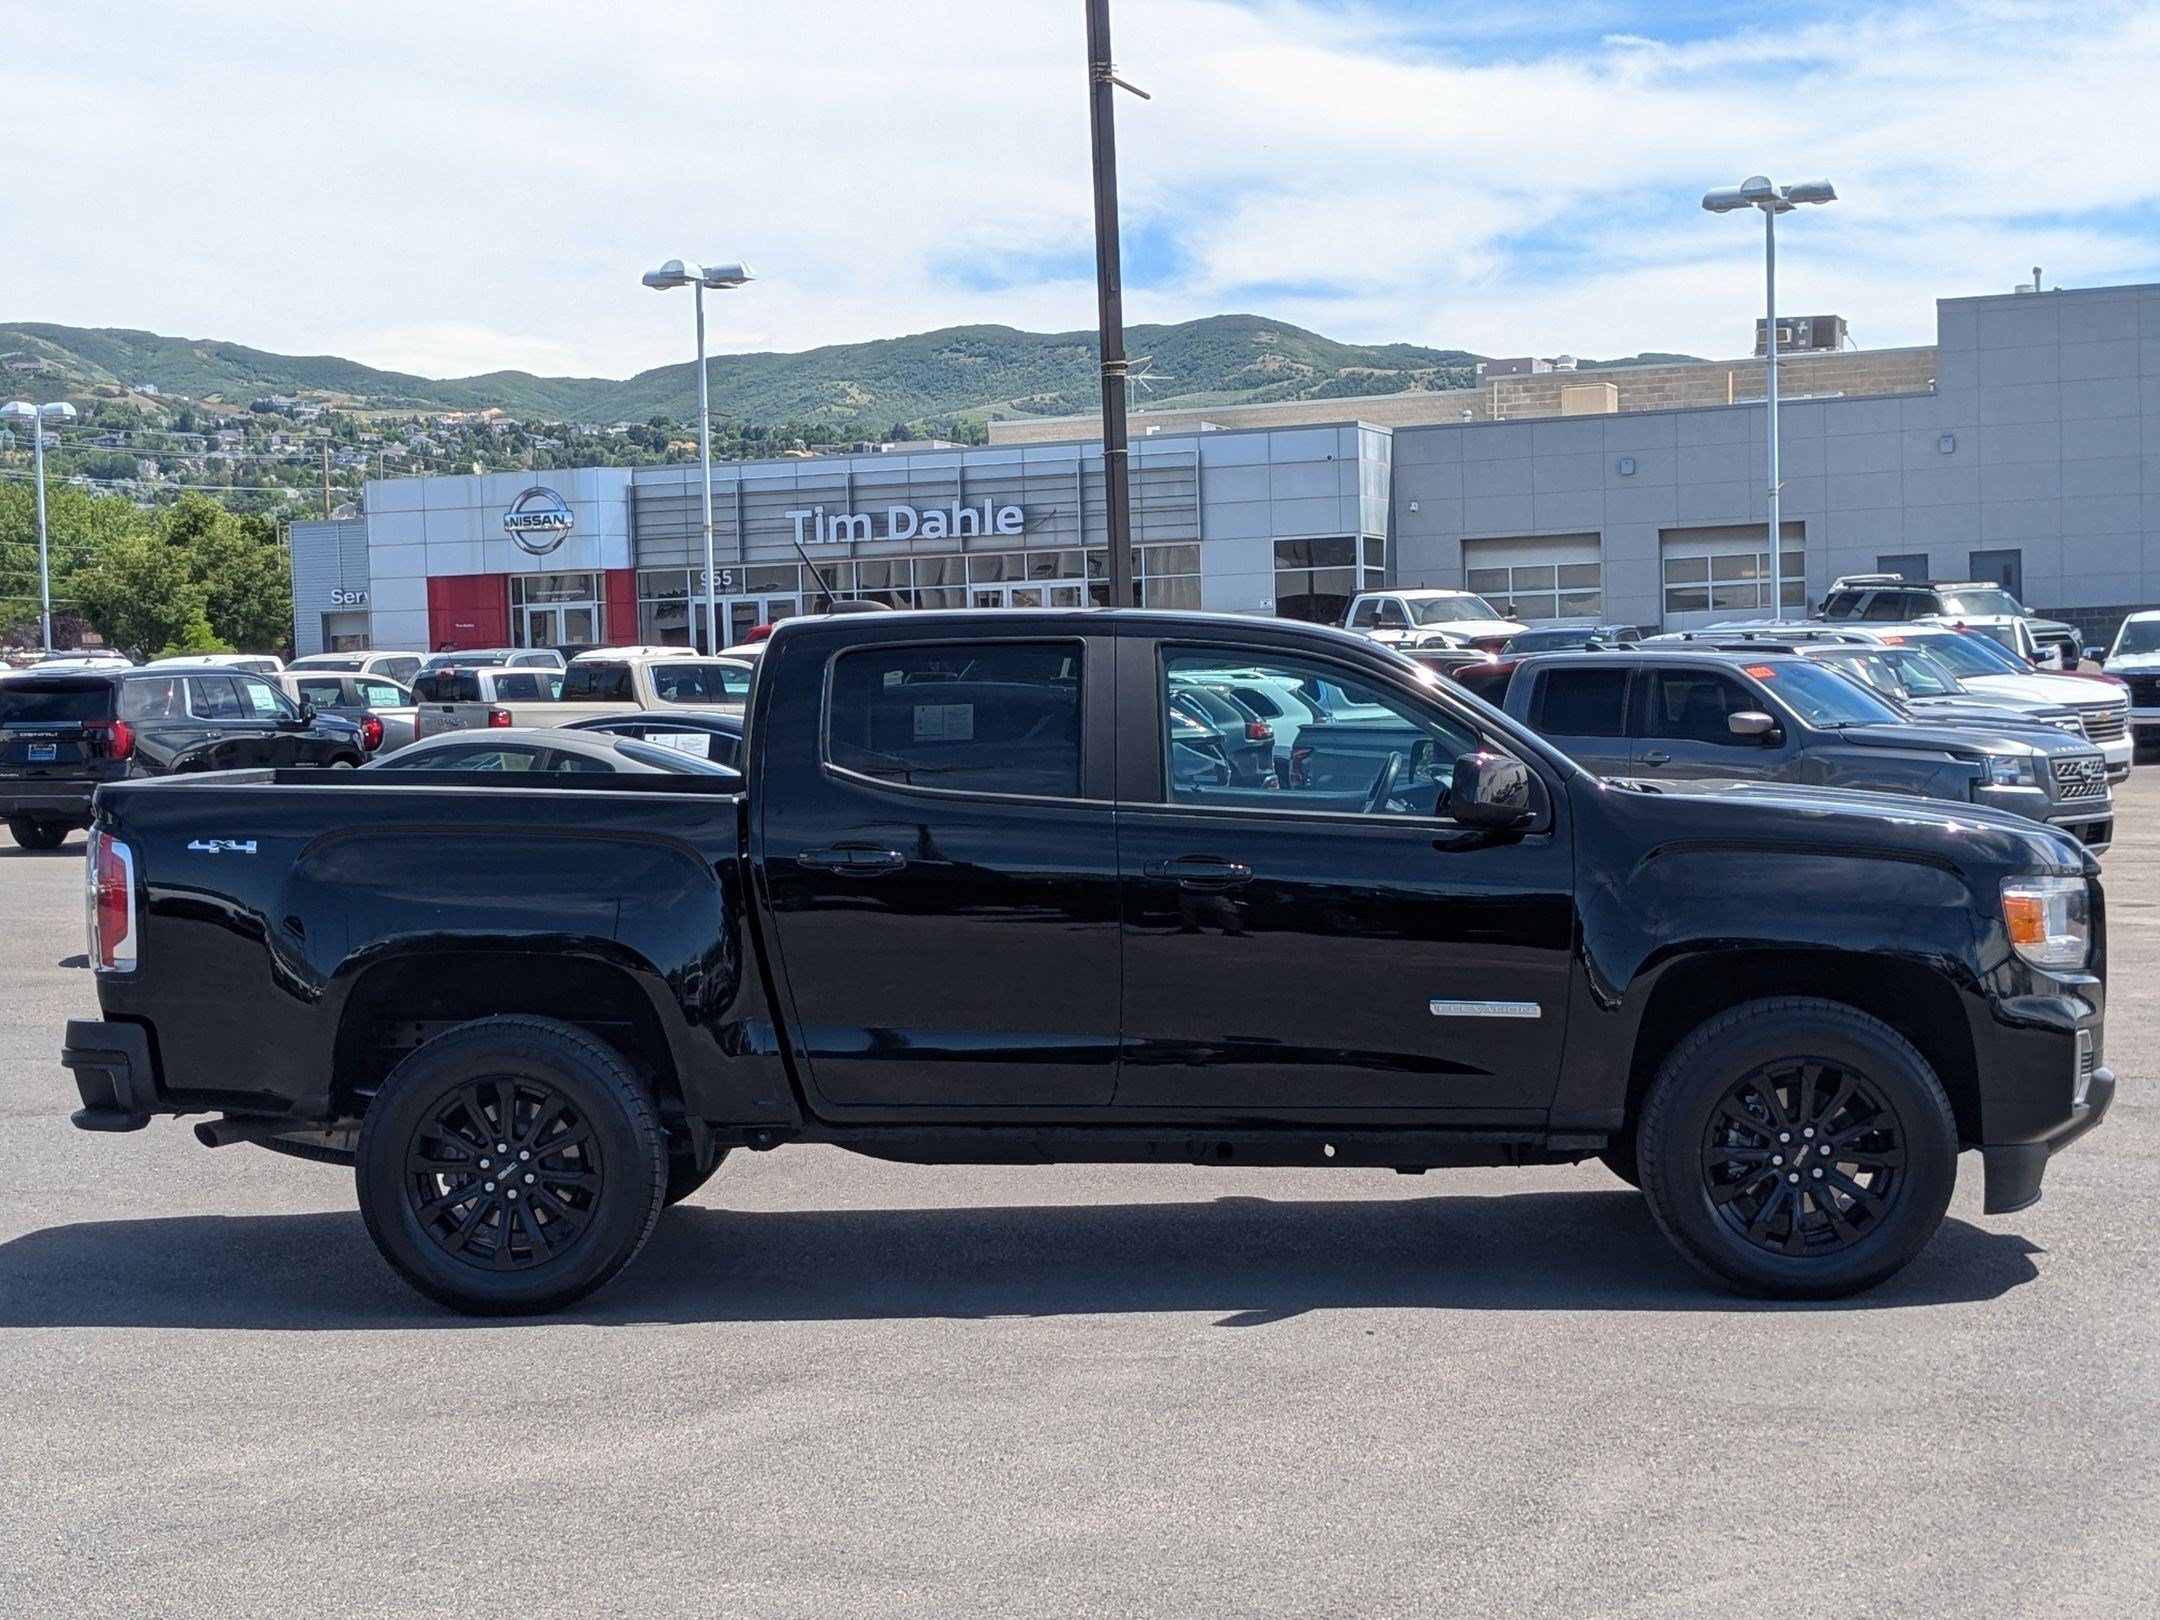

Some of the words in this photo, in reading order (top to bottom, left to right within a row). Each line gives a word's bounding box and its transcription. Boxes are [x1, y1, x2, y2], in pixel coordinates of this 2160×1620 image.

[509, 514, 565, 527] NISSAN
[785, 505, 872, 544] Tim
[887, 498, 1025, 541] Dahle
[1431, 1003, 1537, 1015] ELEVATION
